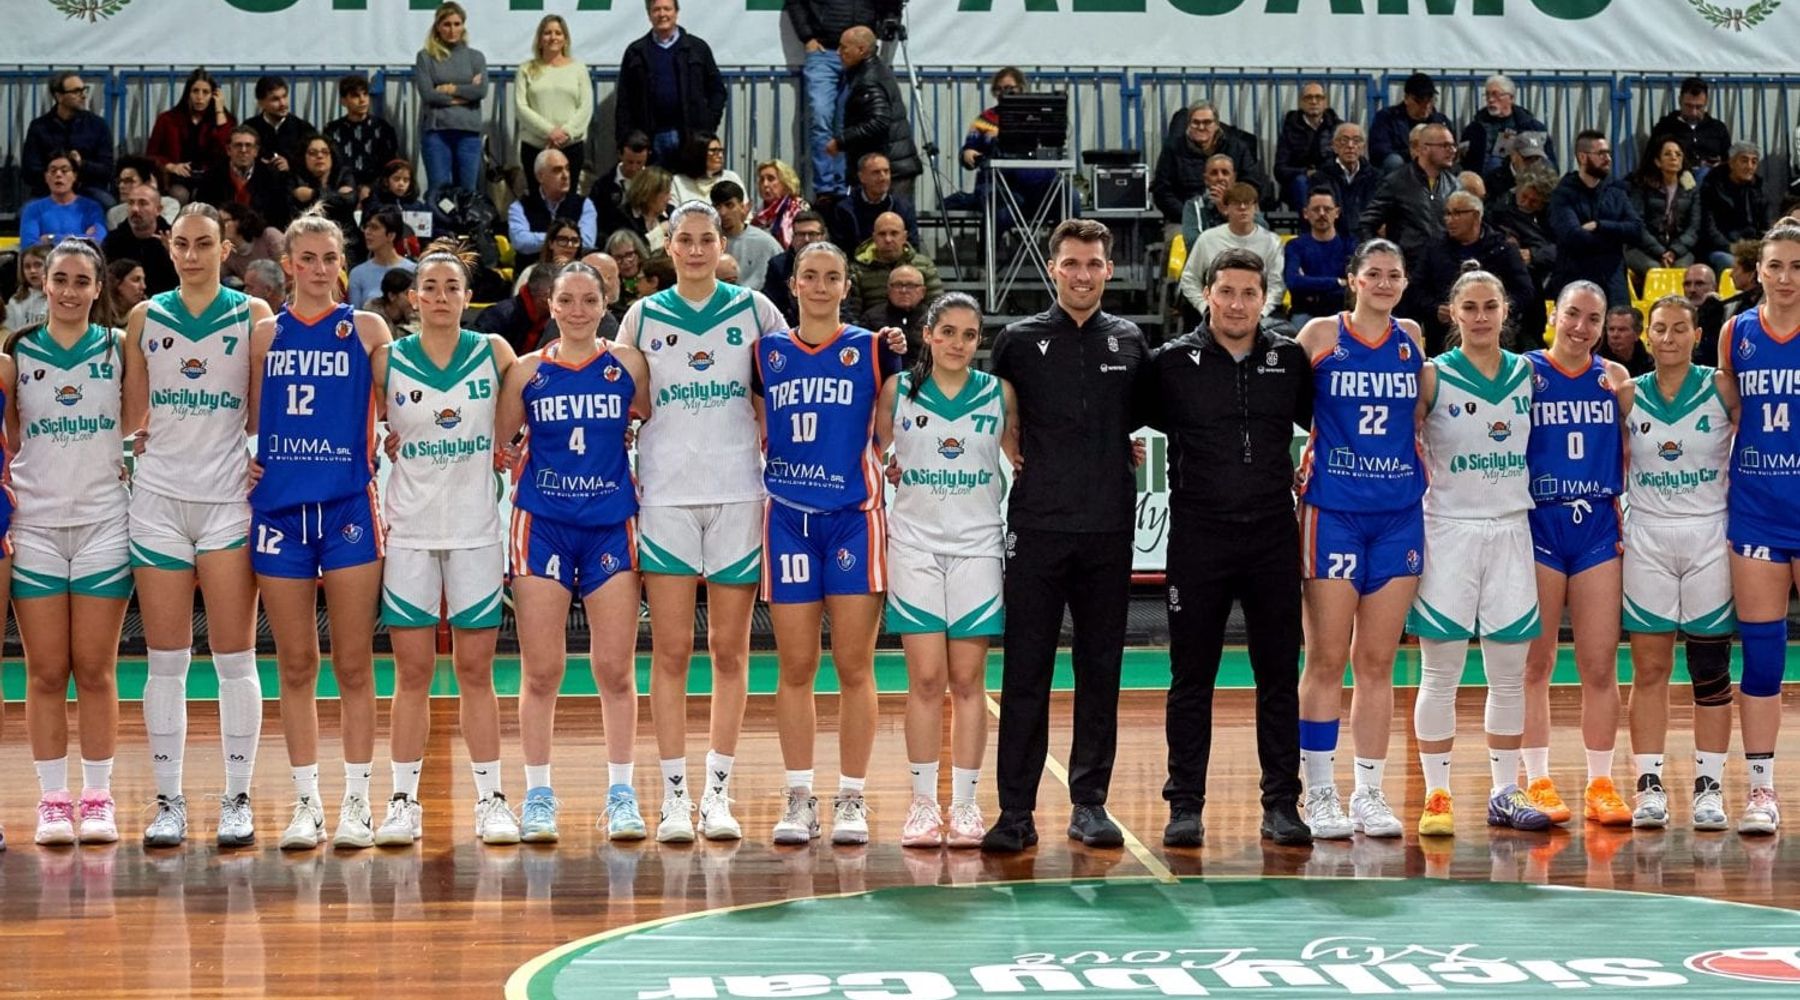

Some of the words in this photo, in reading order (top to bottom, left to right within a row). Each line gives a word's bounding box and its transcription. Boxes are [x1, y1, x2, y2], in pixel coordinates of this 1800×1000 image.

[222, 336, 239, 356] 7
[726, 327, 743, 346] 8
[88, 363, 113, 379] 19
[266, 349, 349, 378] TREVISO
[465, 378, 491, 400] 15
[670, 381, 708, 401] Sicily
[710, 380, 730, 400] by
[729, 380, 746, 398] Ca
[768, 377, 853, 412] TREVISO
[1330, 371, 1417, 398] TREVISO
[1738, 369, 1800, 397] TREVIS
[161, 388, 198, 409] Sicily
[200, 389, 219, 410] by
[220, 391, 242, 411] Car
[286, 384, 316, 416] 12
[530, 393, 622, 422] TREVISO
[683, 399, 700, 416] My
[39, 416, 77, 435] Sicily
[78, 415, 97, 433] by
[98, 414, 116, 430] Car
[971, 414, 998, 435] 77
[1359, 405, 1389, 435] 22
[1531, 400, 1614, 427] TREVISO
[1695, 415, 1711, 433] 4
[1762, 402, 1790, 432] 14
[569, 426, 586, 455] 4
[790, 412, 818, 443] 10
[418, 438, 457, 457] Sicily
[458, 437, 475, 455] by
[476, 435, 492, 452] Ca
[1568, 432, 1584, 460] 0
[1468, 452, 1506, 471] Sicily
[1507, 451, 1526, 470] by
[919, 467, 956, 489] Sicily
[957, 468, 976, 488] by
[1642, 471, 1679, 489] Sicily
[1680, 469, 1699, 487] by
[1699, 467, 1719, 482] Car
[256, 524, 285, 555] 12
[545, 554, 561, 580] 4
[780, 554, 810, 584] 10
[1328, 553, 1357, 579] 22
[1013, 947, 1259, 969] Love
[1300, 936, 1508, 967] My
[637, 971, 959, 1000] Car
[969, 961, 1211, 996] by
[1212, 957, 1689, 995] Sicily
